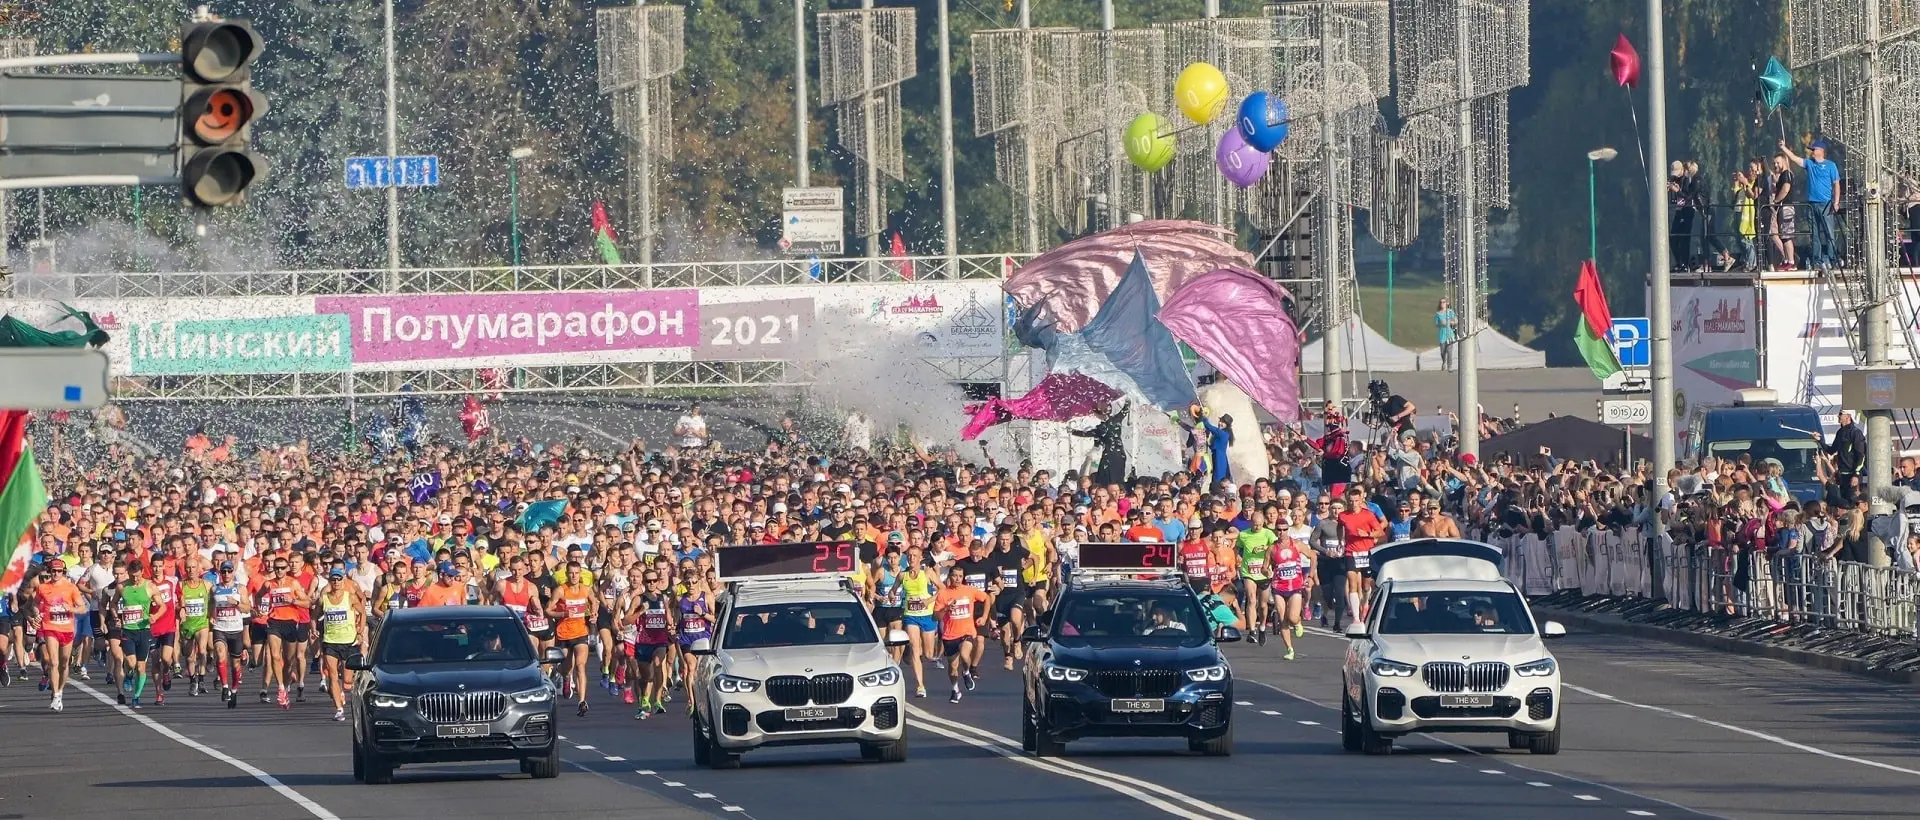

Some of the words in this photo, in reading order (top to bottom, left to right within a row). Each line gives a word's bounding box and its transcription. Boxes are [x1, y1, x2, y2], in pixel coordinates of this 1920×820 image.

[137, 320, 343, 361] Минский
[362, 303, 684, 349] Полумарафон
[712, 314, 800, 347] 2021
[1621, 408, 1629, 416] 15
[1632, 408, 1645, 417] 20
[812, 543, 852, 572] 25
[1142, 545, 1171, 566] 24
